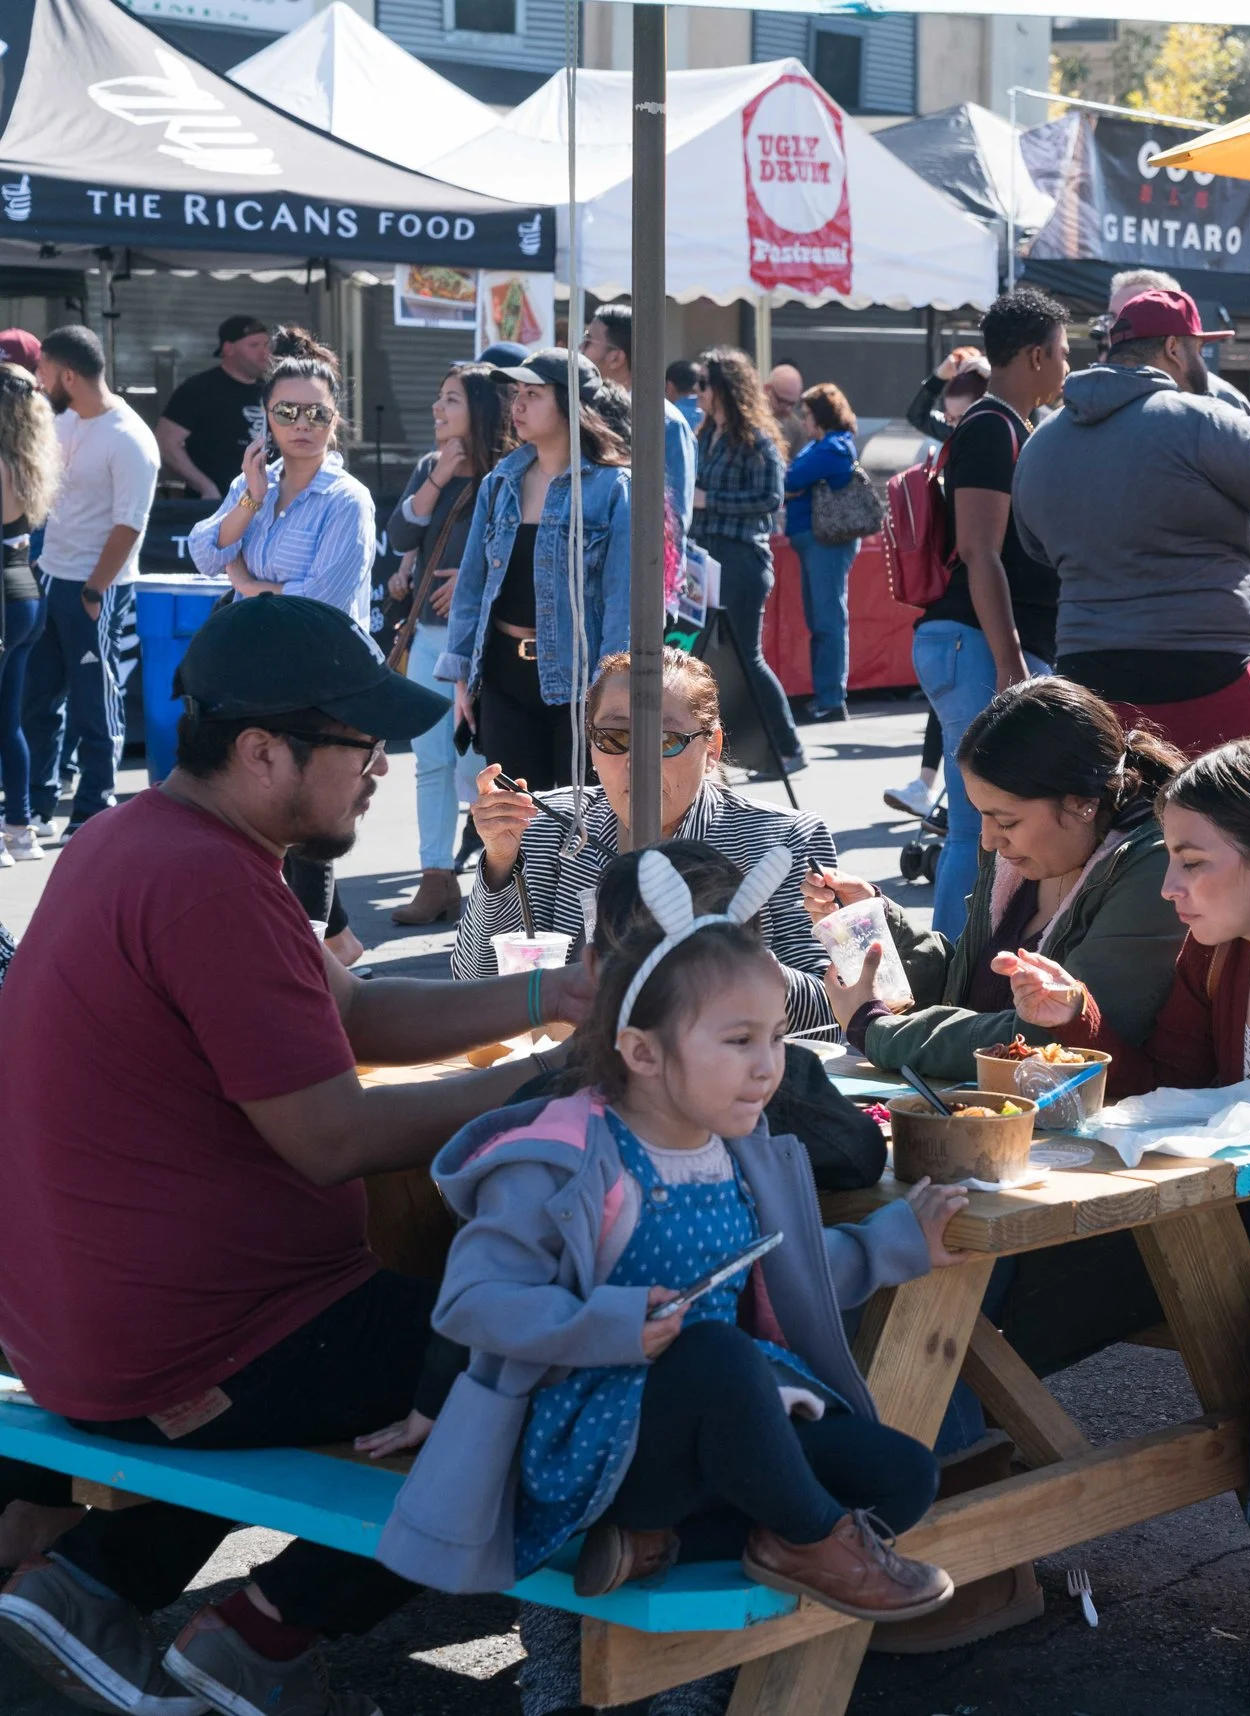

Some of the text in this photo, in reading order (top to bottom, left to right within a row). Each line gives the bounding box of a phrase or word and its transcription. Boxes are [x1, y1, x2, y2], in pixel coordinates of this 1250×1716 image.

[758, 135, 820, 158] UGLY
[759, 160, 831, 184] DRUM
[86, 190, 476, 241] THE RICANS FOOD
[1103, 213, 1242, 255] GENTARO
